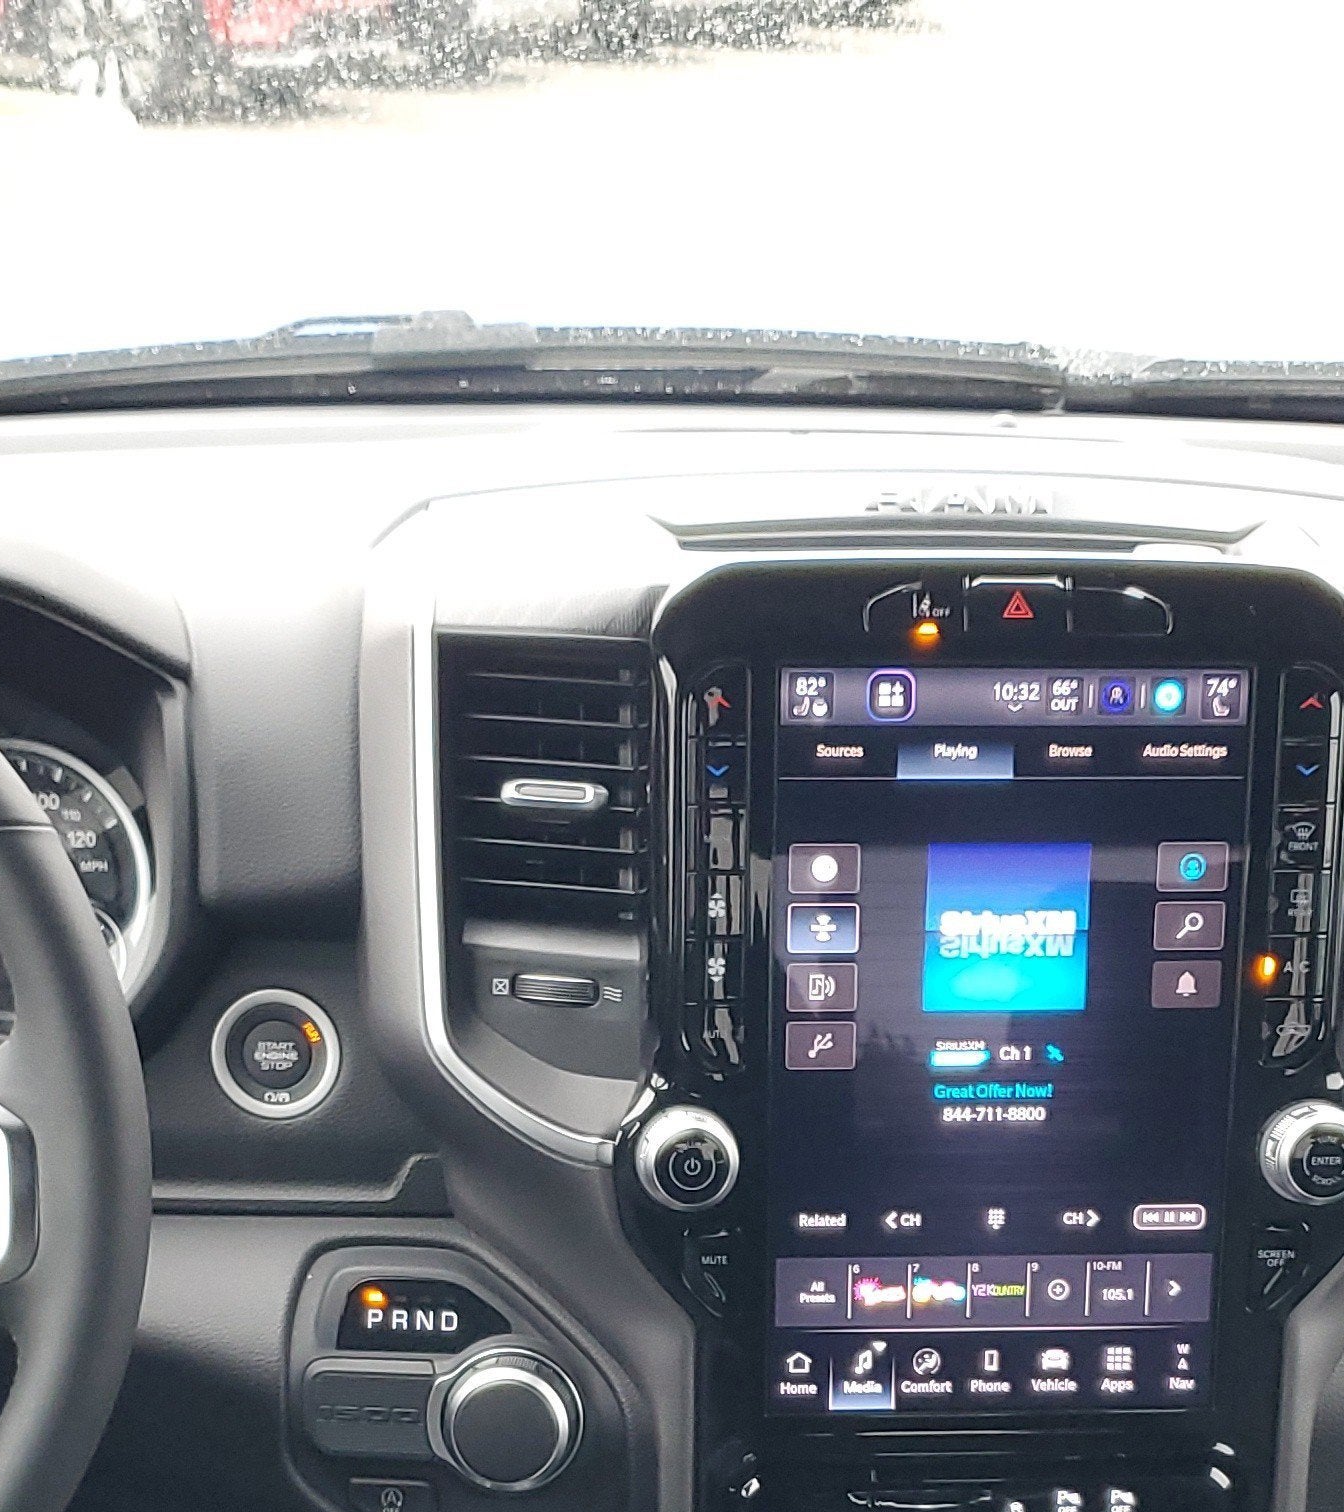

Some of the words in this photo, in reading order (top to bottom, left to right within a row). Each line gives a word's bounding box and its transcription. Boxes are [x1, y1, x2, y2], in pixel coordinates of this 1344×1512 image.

[993, 682, 1040, 701] 10:32
[1051, 697, 1079, 711] OUT
[816, 744, 864, 758] Sources
[934, 743, 978, 760] Playing
[1048, 744, 1093, 758] Browse
[1143, 743, 1179, 757] Audio
[1179, 743, 1228, 759] Settings
[67, 831, 97, 849] 120
[939, 910, 1077, 936] SiriusXM
[1283, 960, 1311, 974] AC
[257, 1041, 297, 1051] START
[999, 1046, 1020, 1061] Ch
[1023, 1046, 1033, 1061] 1
[260, 1061, 293, 1071] STOP
[934, 1085, 974, 1099] Great
[976, 1084, 1014, 1099] Offer
[1015, 1083, 1054, 1098] Now!
[942, 1107, 1047, 1122] 844-711-8800
[1311, 1156, 1342, 1165] ENTER
[799, 1213, 847, 1228] Related
[900, 1213, 922, 1227] CH
[1062, 1212, 1084, 1225] CH
[701, 1255, 729, 1265] MUTE
[1257, 1250, 1295, 1259] SCREEN
[1093, 1261, 1123, 1271] 10-FM
[1102, 1288, 1134, 1300] 105.1
[780, 1382, 818, 1395] Home
[843, 1381, 882, 1394] Media
[901, 1380, 953, 1394] Comfort
[970, 1379, 1010, 1392] Phone
[1031, 1378, 1077, 1391] Vehicle
[1101, 1378, 1134, 1393] Apps
[1169, 1377, 1195, 1390] Nav
